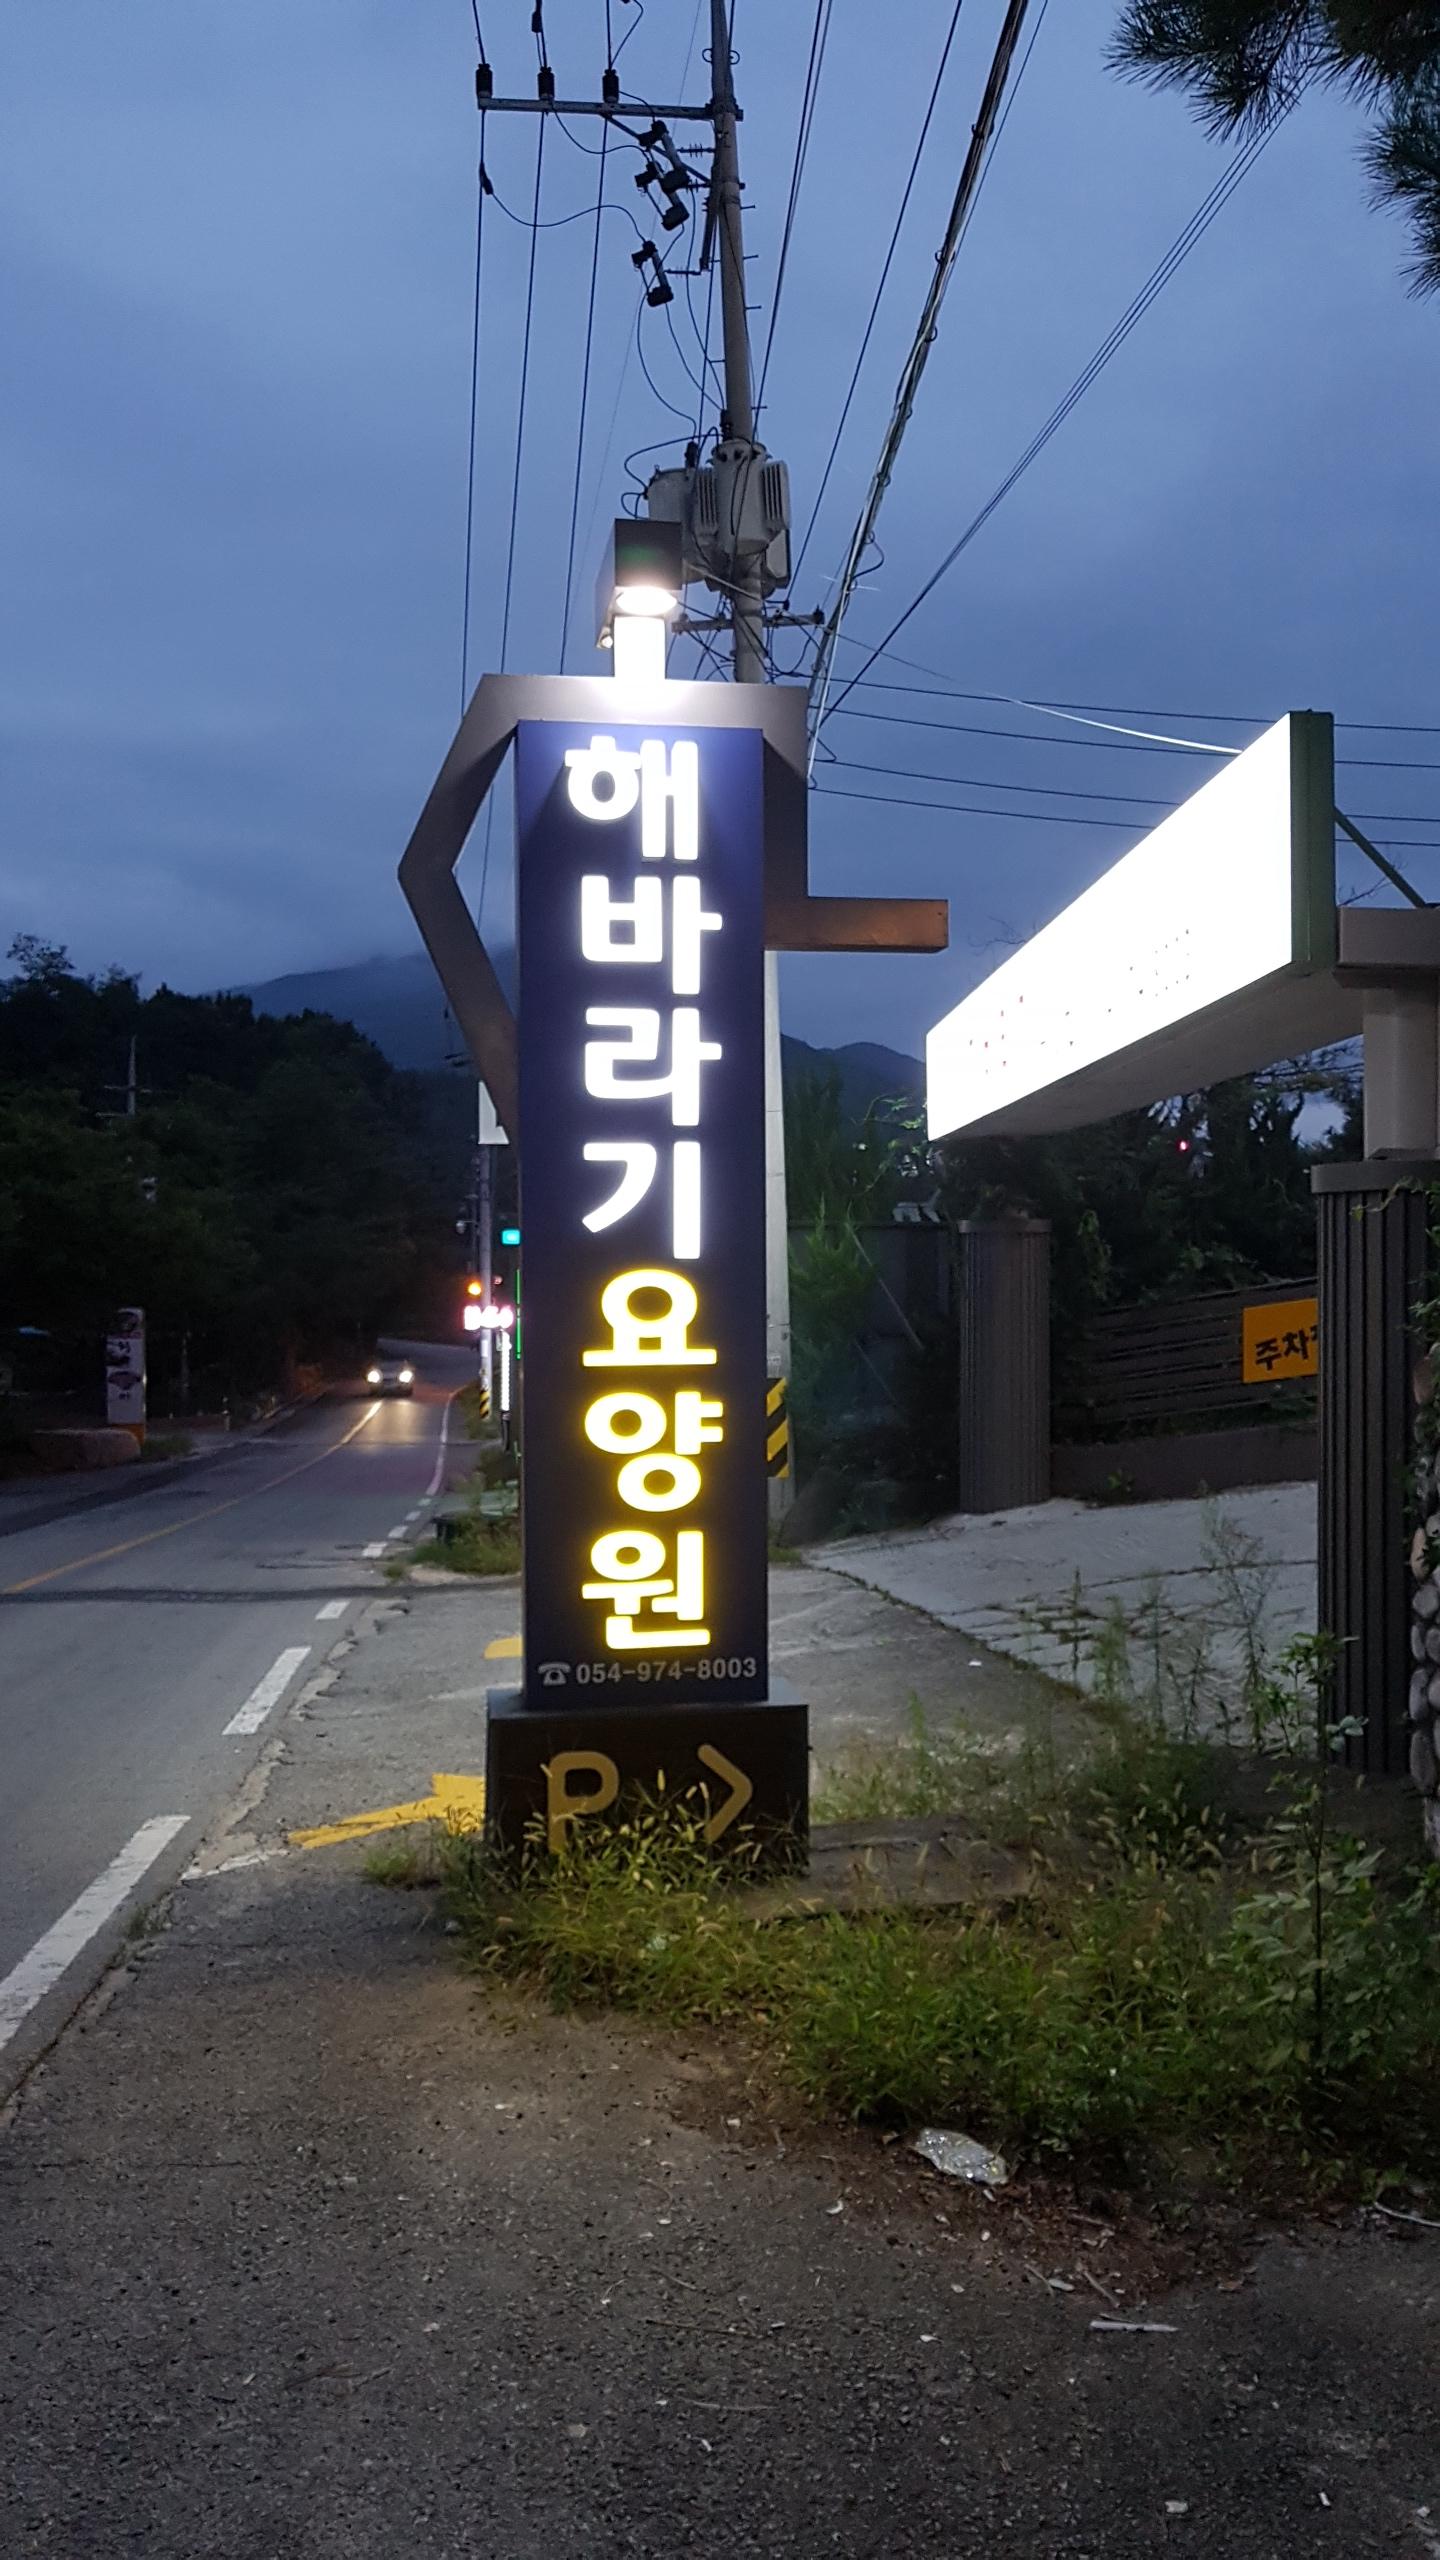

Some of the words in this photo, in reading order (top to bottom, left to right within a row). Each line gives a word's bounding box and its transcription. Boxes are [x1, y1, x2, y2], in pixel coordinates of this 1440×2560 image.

[565, 736, 722, 1260] 해바라기
[582, 1268, 724, 1650] 요양원
[576, 1657, 757, 1684] 054-974-8003
[546, 1750, 620, 1855] P
